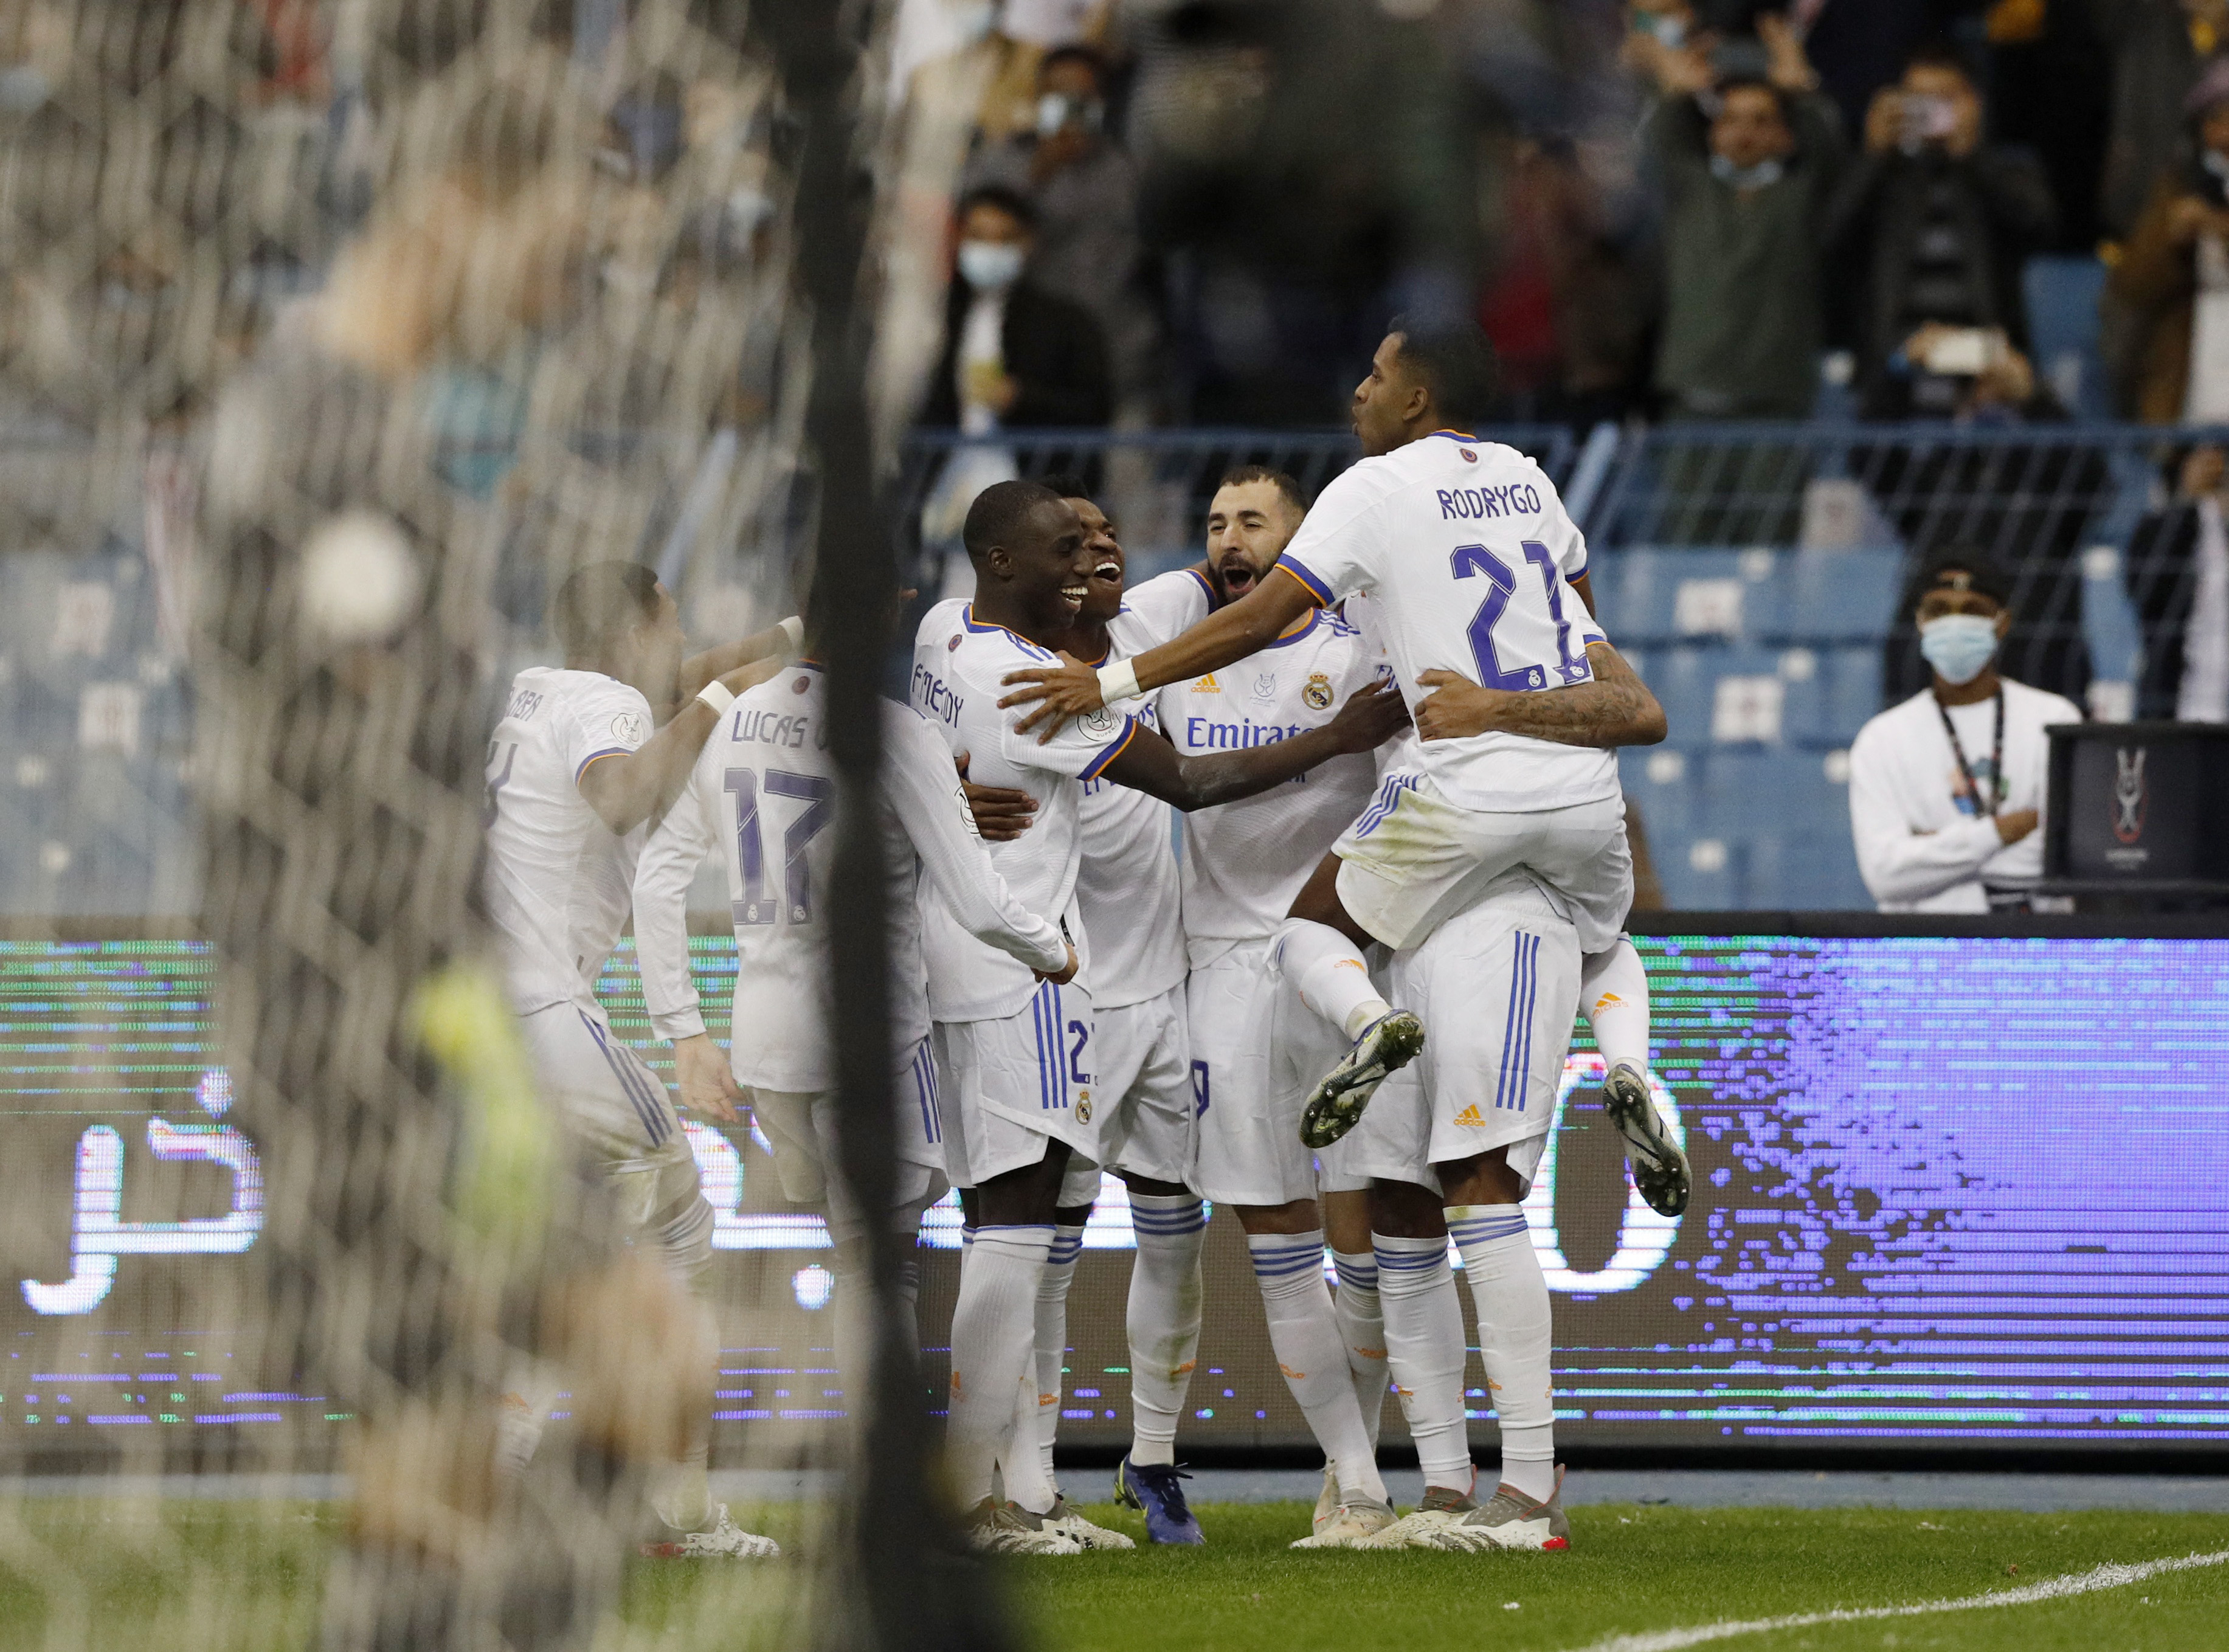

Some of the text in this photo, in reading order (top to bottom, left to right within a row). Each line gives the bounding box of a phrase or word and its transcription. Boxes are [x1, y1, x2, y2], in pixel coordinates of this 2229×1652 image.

[1436, 484, 1541, 520] RODRYGO
[1450, 540, 1592, 692] 21
[1191, 685, 1222, 694] adidas
[731, 710, 809, 748] LUCAS
[1187, 716, 1316, 749] Emirat
[724, 767, 837, 925] 17
[1068, 1019, 1099, 1086] 2
